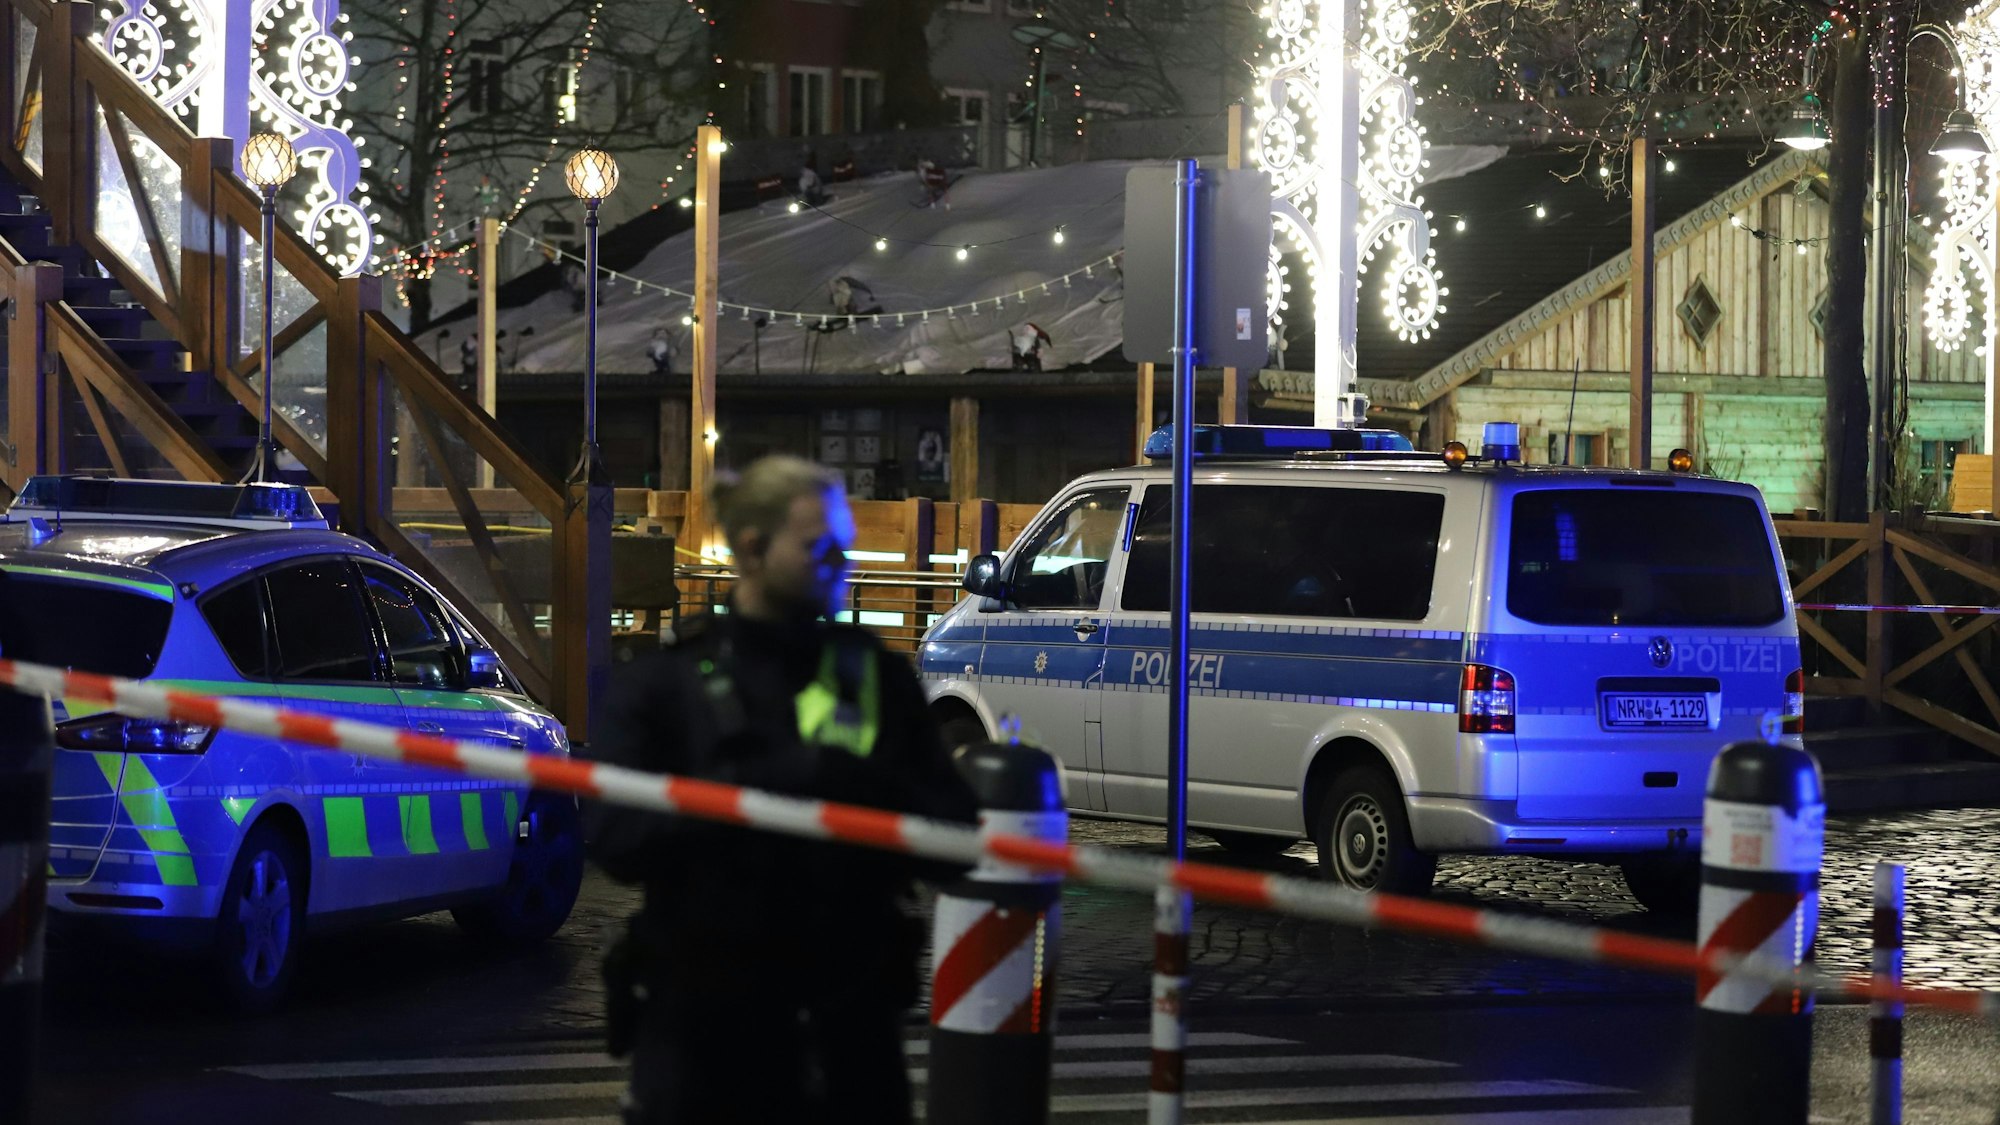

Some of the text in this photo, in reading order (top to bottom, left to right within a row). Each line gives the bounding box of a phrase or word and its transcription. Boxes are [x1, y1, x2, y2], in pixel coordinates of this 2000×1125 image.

[1129, 651, 1224, 689] POLZEI
[1678, 644, 1782, 673] POLIZEI
[1617, 699, 1704, 719] NRW 4-1129
